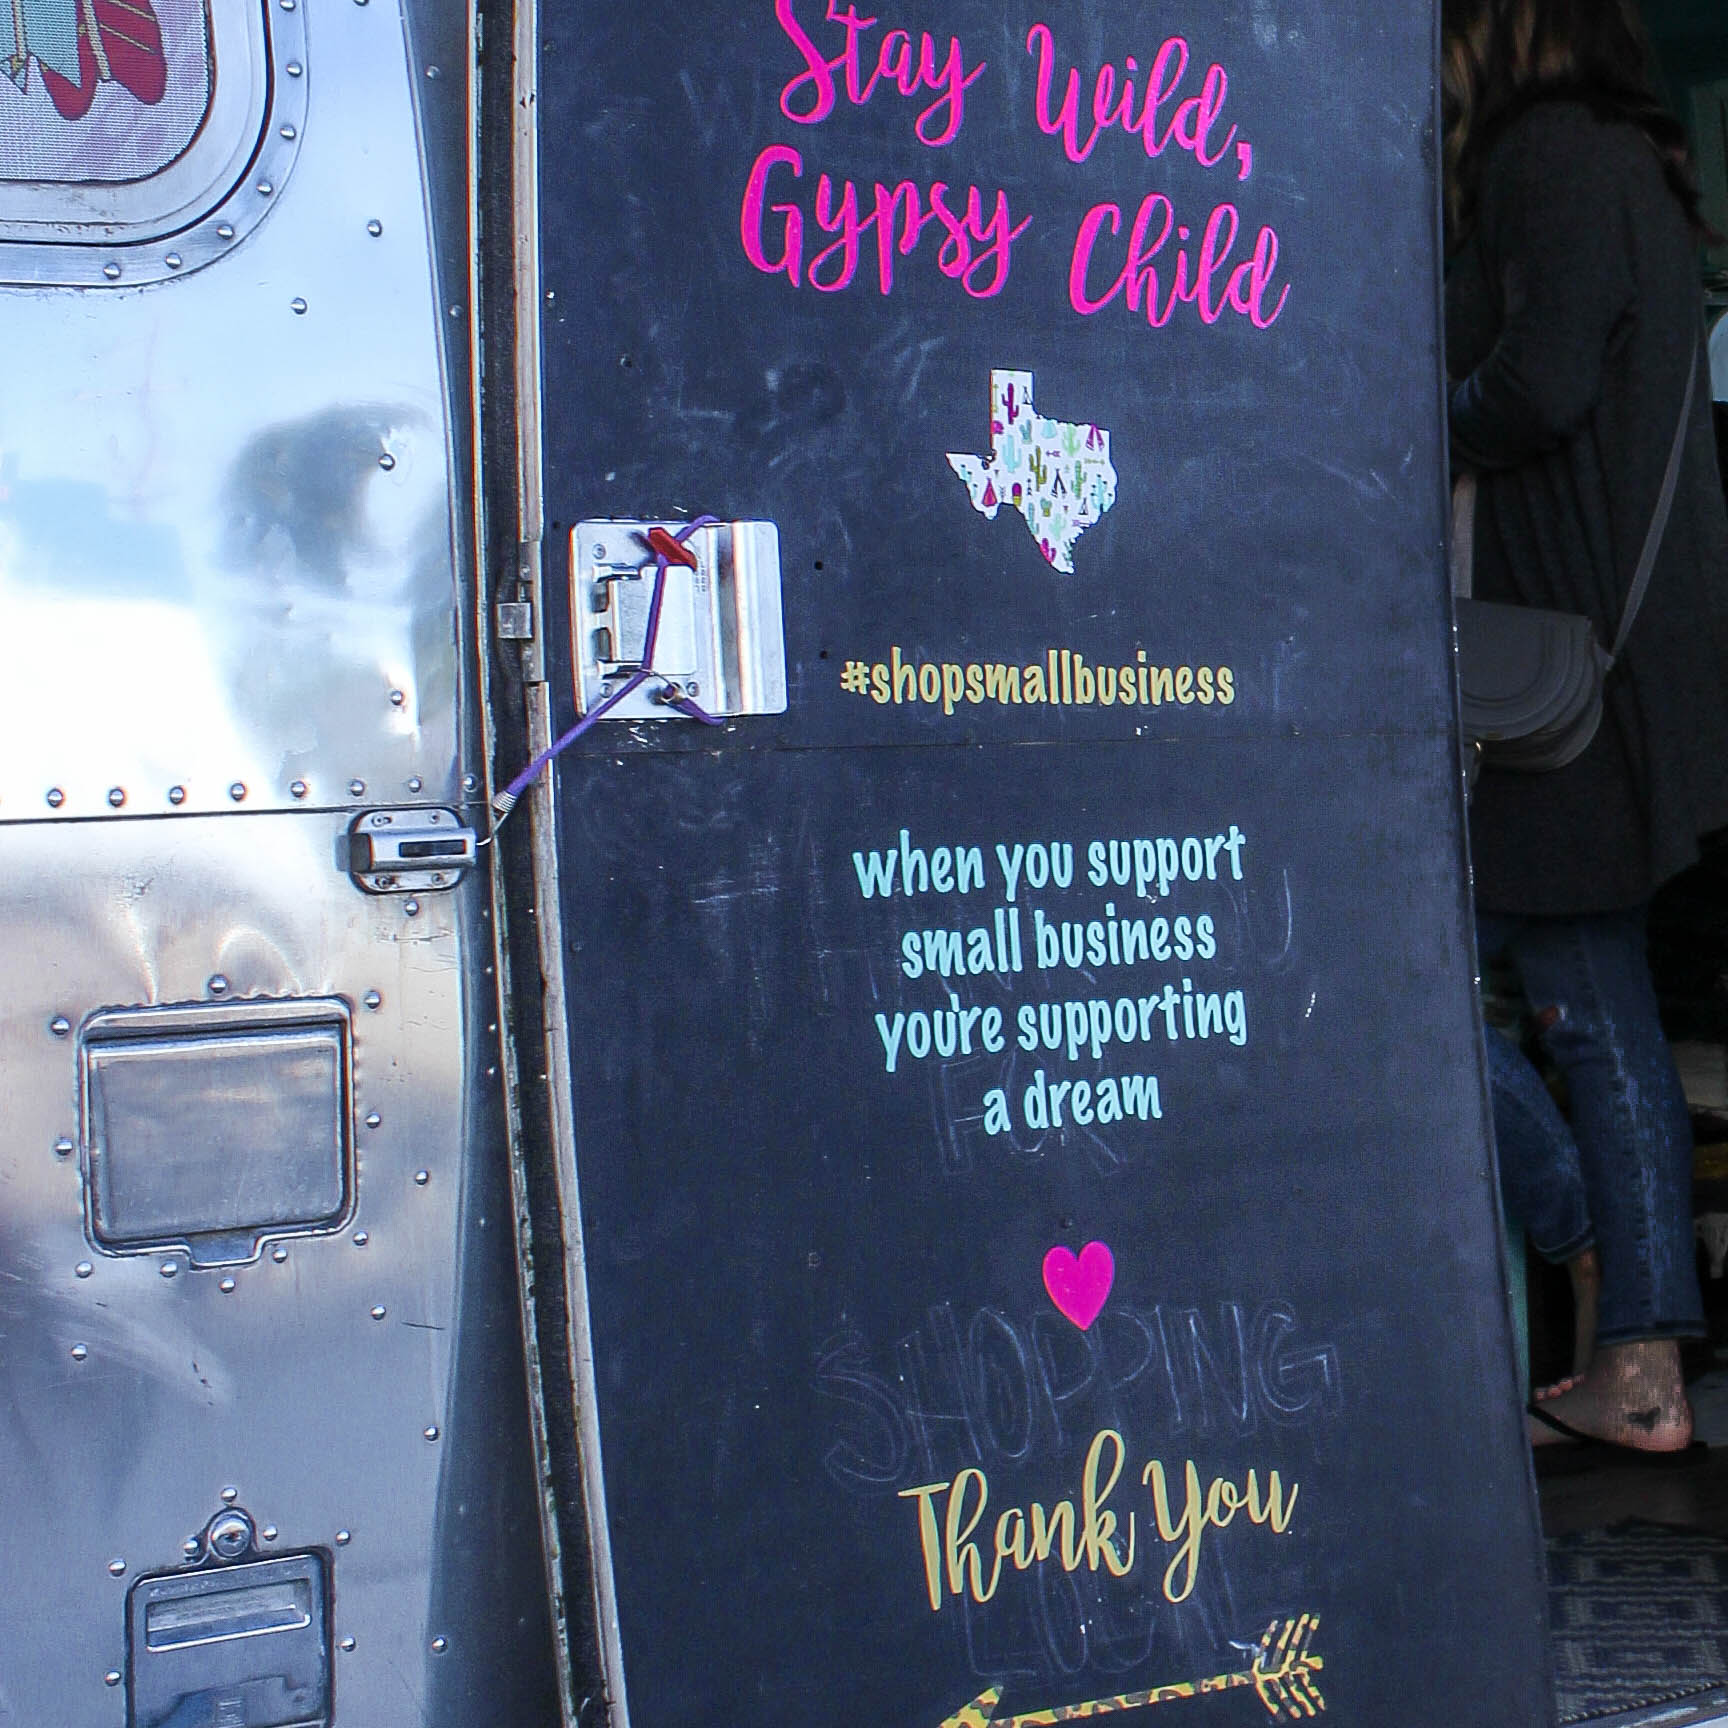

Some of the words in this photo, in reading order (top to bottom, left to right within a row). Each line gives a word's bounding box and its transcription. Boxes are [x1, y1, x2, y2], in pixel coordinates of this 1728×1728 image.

[1026, 23, 1252, 182] Wild,
[740, 144, 1032, 299] Gypsy
[1068, 191, 1291, 330] Child
[839, 645, 1236, 715] #shopsmallbusiness
[852, 828, 985, 900] when
[995, 840, 1074, 904] you
[1086, 824, 1245, 898] support
[900, 907, 1022, 980] small
[1032, 902, 1216, 970] business
[874, 992, 1006, 1074] you're
[1016, 977, 1248, 1062] supporting
[982, 1088, 1012, 1136] a
[1023, 1069, 1163, 1130] dream
[898, 1428, 1137, 1612] Thank
[1141, 1458, 1300, 1604] You
